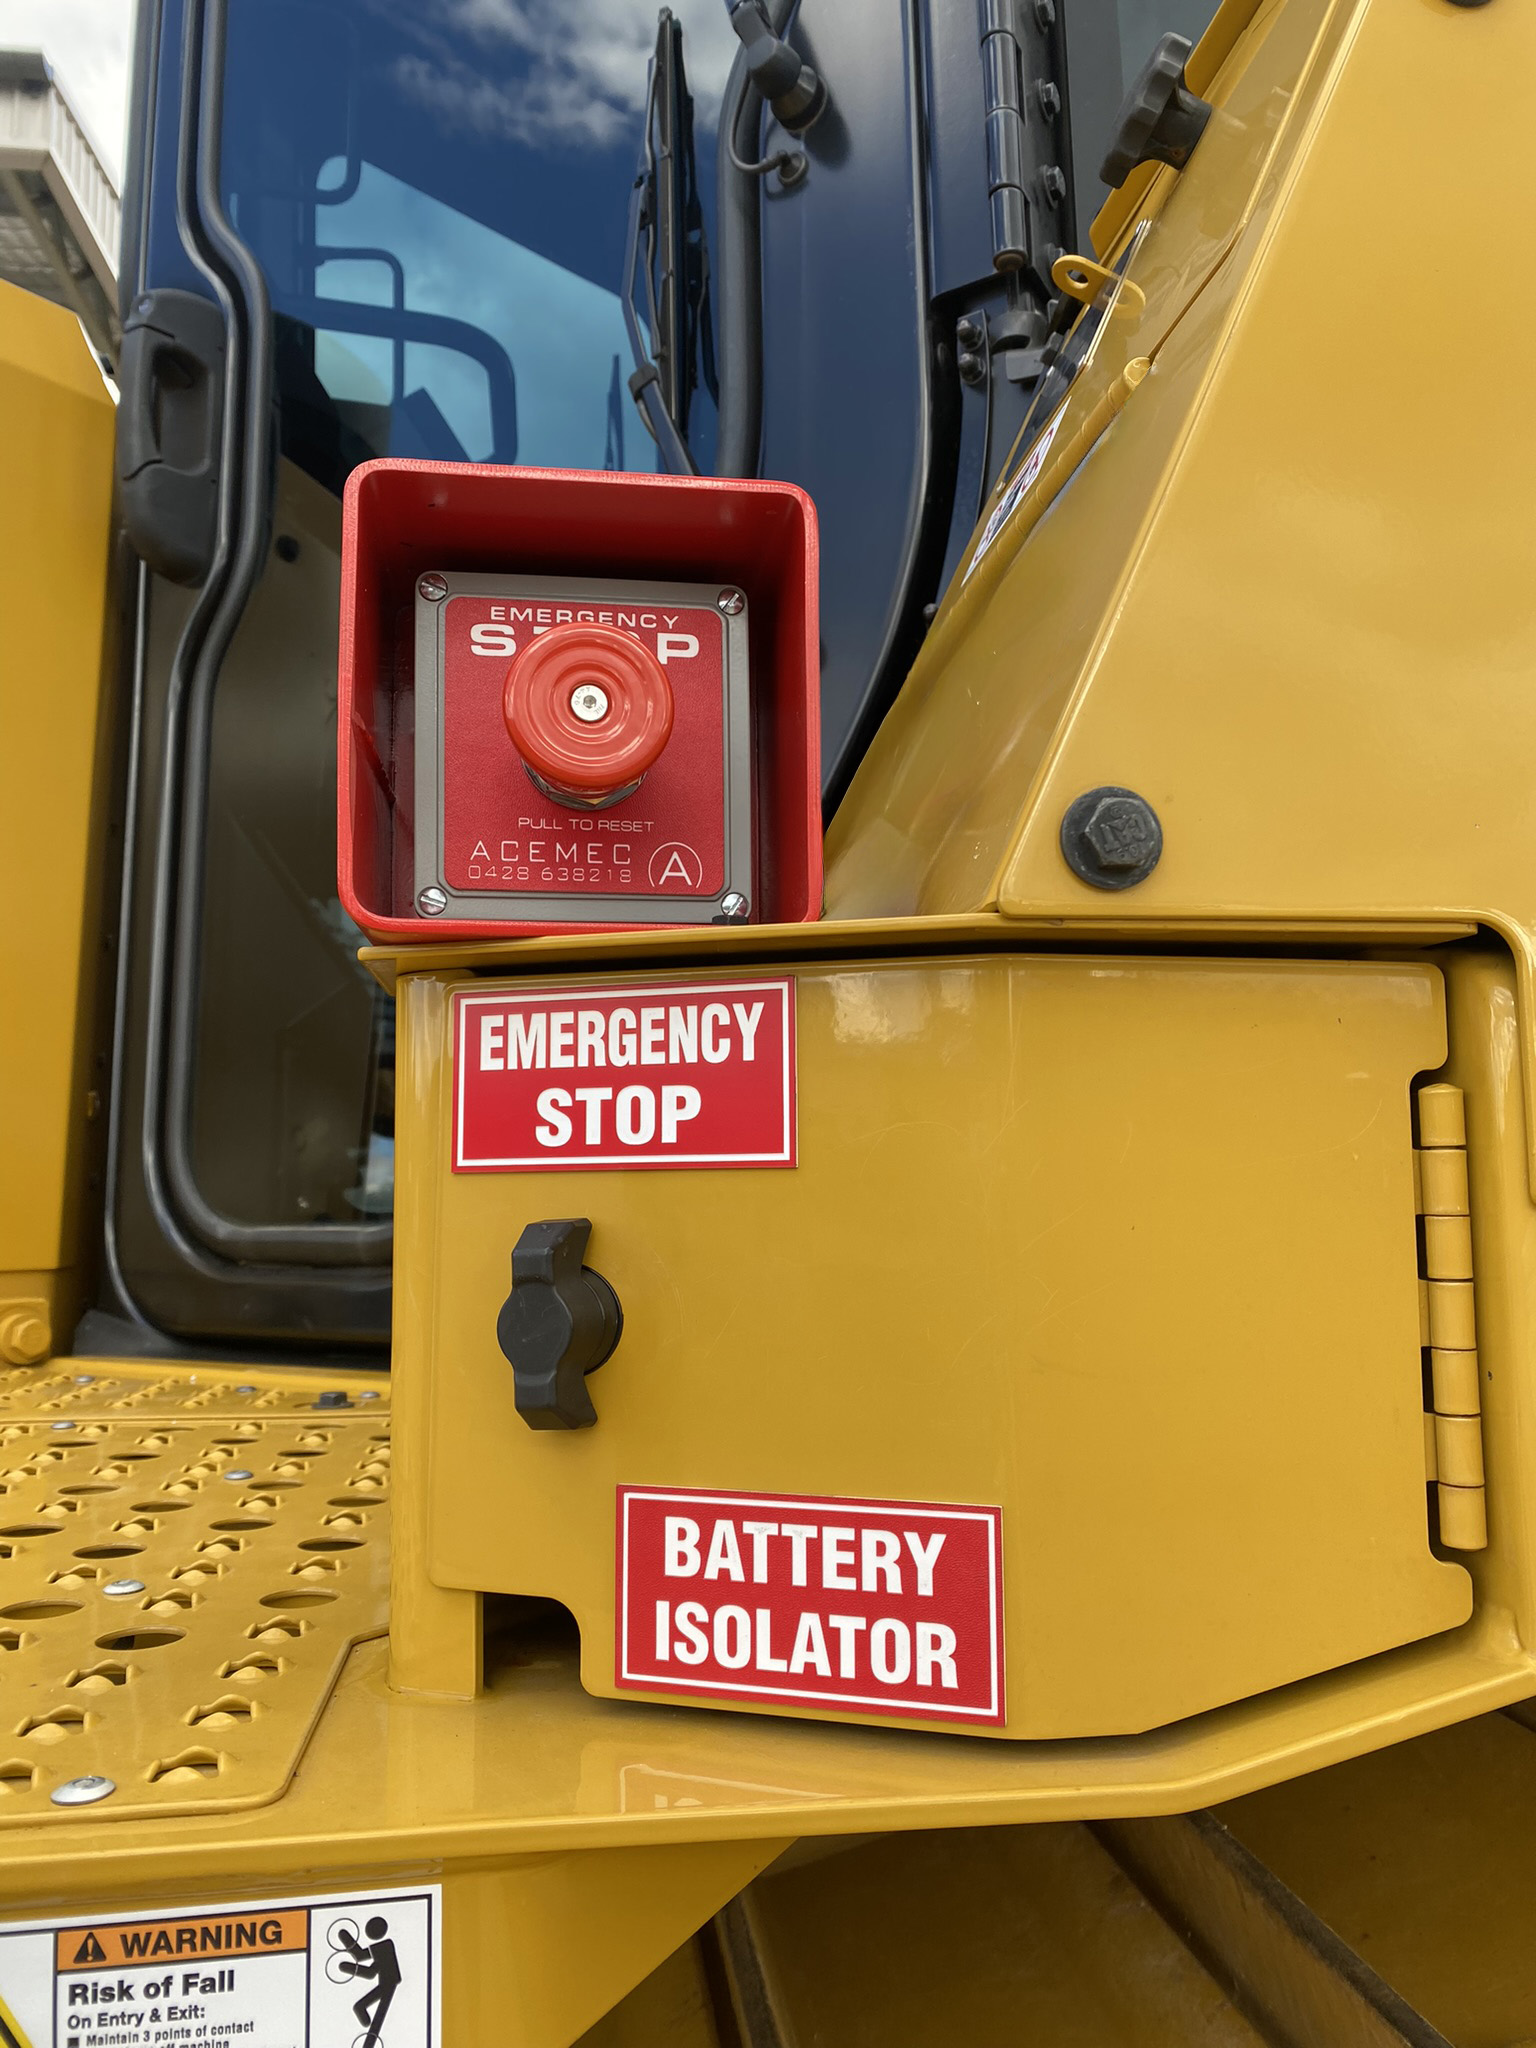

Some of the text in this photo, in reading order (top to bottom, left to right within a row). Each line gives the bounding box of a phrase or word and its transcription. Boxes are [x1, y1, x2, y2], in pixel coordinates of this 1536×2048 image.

[489, 606, 679, 630] EMERGENCY
[470, 623, 700, 665] SP
[518, 817, 655, 833] PULL TO RESET
[470, 840, 631, 865] ACEMEC
[468, 865, 632, 883] 0428 638218
[479, 1002, 765, 1071] EMERGENCY
[535, 1085, 702, 1147] STOP
[664, 1515, 947, 1597] BATTERY
[654, 1600, 959, 1689] ISOLATOR
[119, 1919, 282, 1959] WARNING
[68, 1969, 235, 2007] Risk of Fall
[67, 2004, 205, 2030] On Entry & Exit:
[86, 2020, 255, 2047] Maintain 3 points of contact
